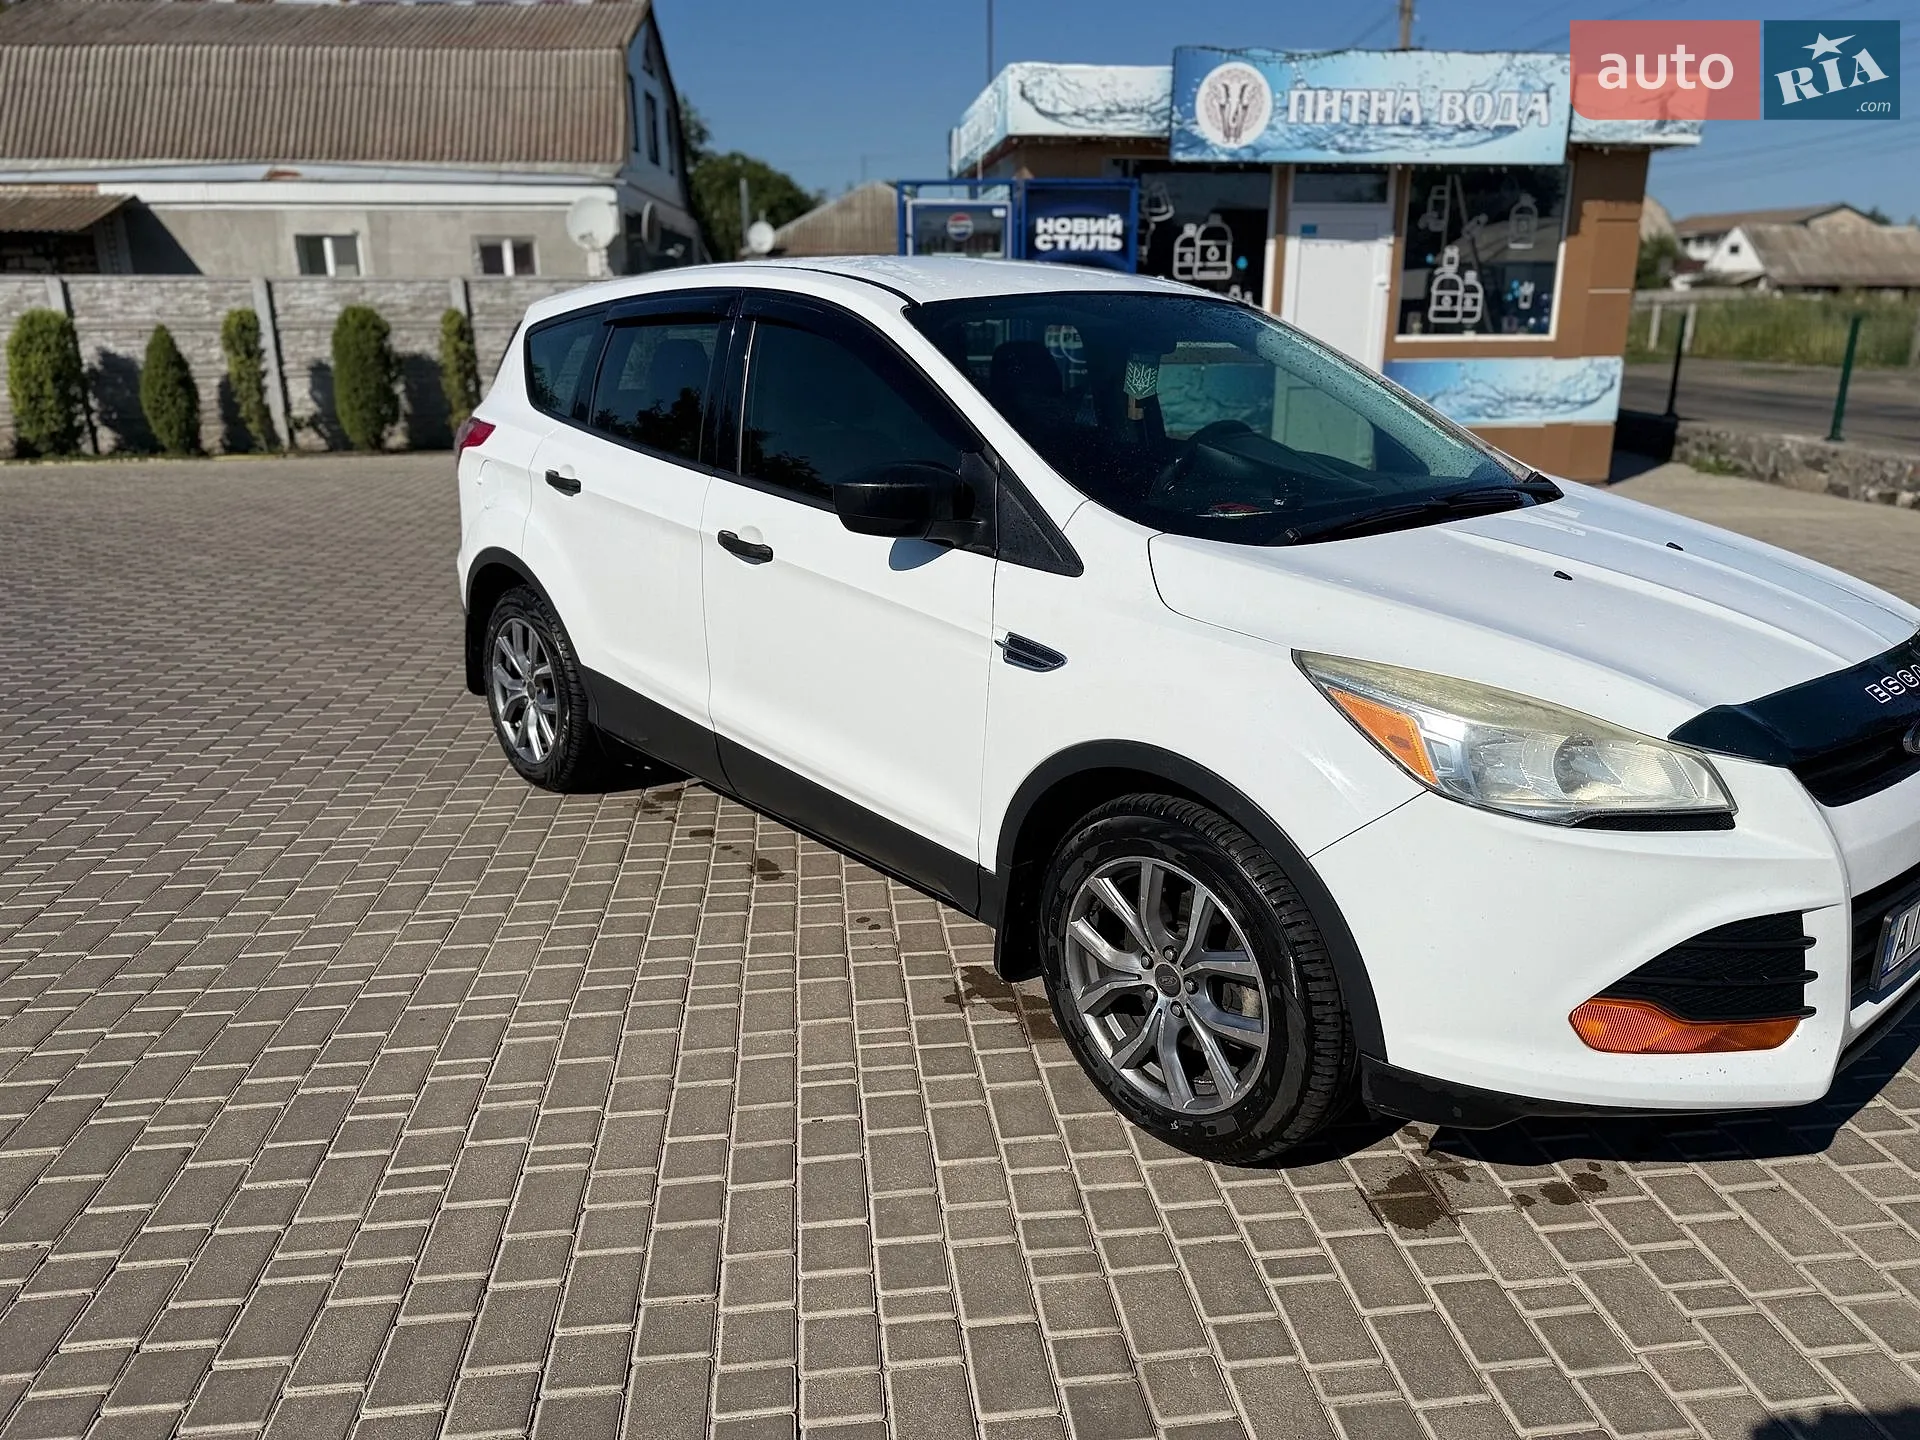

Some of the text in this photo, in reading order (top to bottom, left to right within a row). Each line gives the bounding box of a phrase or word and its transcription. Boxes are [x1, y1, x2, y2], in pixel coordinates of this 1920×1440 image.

[1287, 88, 1550, 129] ПИТНА ВОДА
[1035, 213, 1123, 235] НОВИЙ
[1034, 233, 1123, 251] СТИЛЬ
